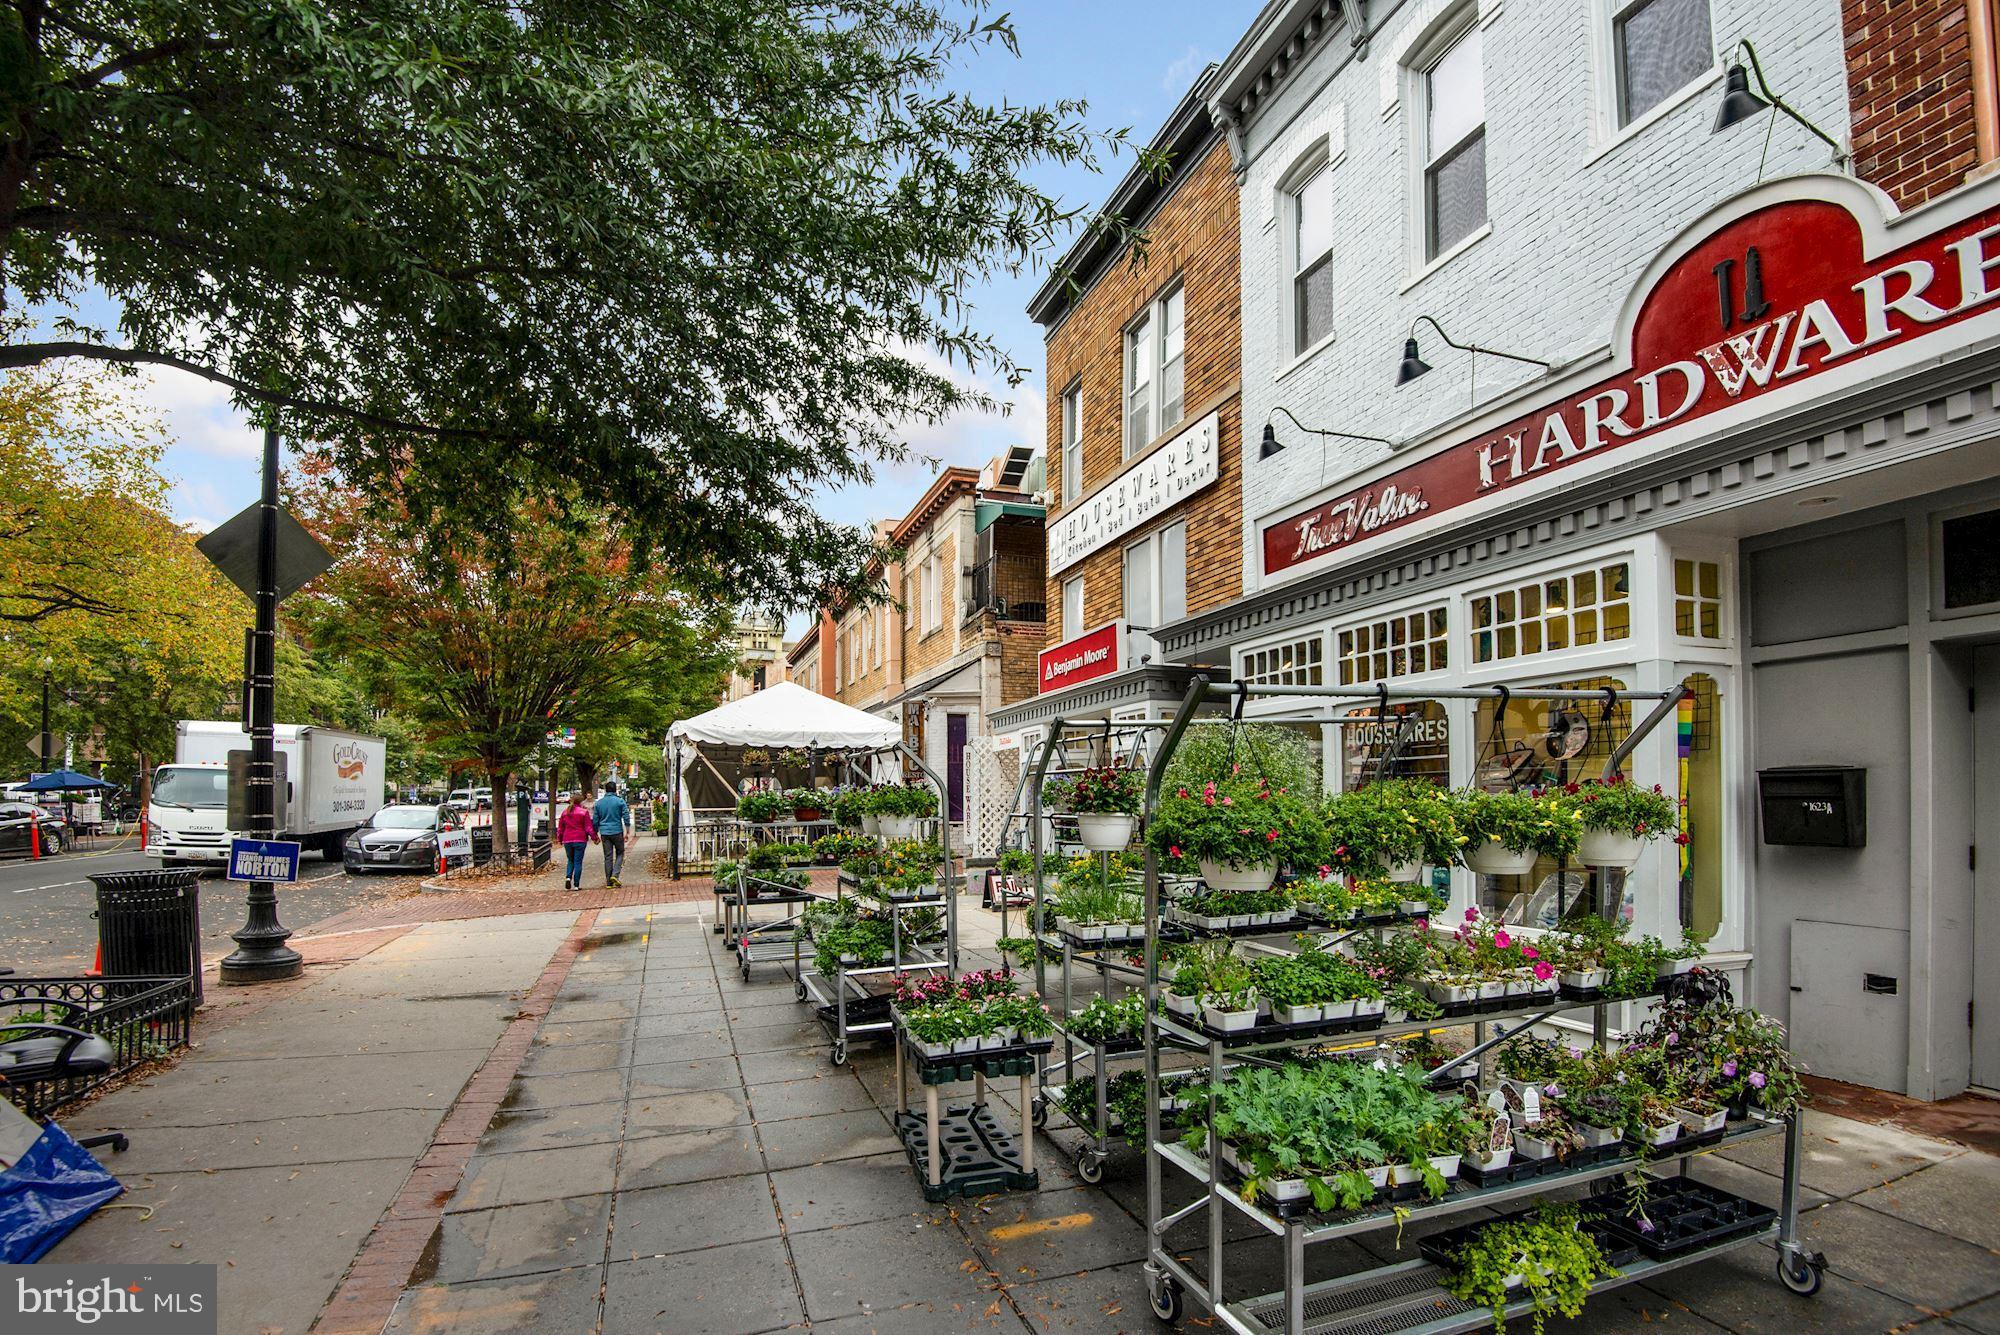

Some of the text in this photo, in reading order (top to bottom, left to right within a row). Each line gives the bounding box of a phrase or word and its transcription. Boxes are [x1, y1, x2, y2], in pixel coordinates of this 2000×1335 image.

[1474, 222, 2000, 493] HARDWARE
[1067, 426, 1211, 542] HOUSEWARES
[1067, 462, 1212, 558] Kitchen Bed Bath Decor
[1291, 512, 1345, 562] True
[1053, 652, 1084, 677] Benjamin
[235, 860, 290, 877] NORTON
[237, 853, 263, 863] ELEANOR
[263, 856, 291, 864] HOLMES
